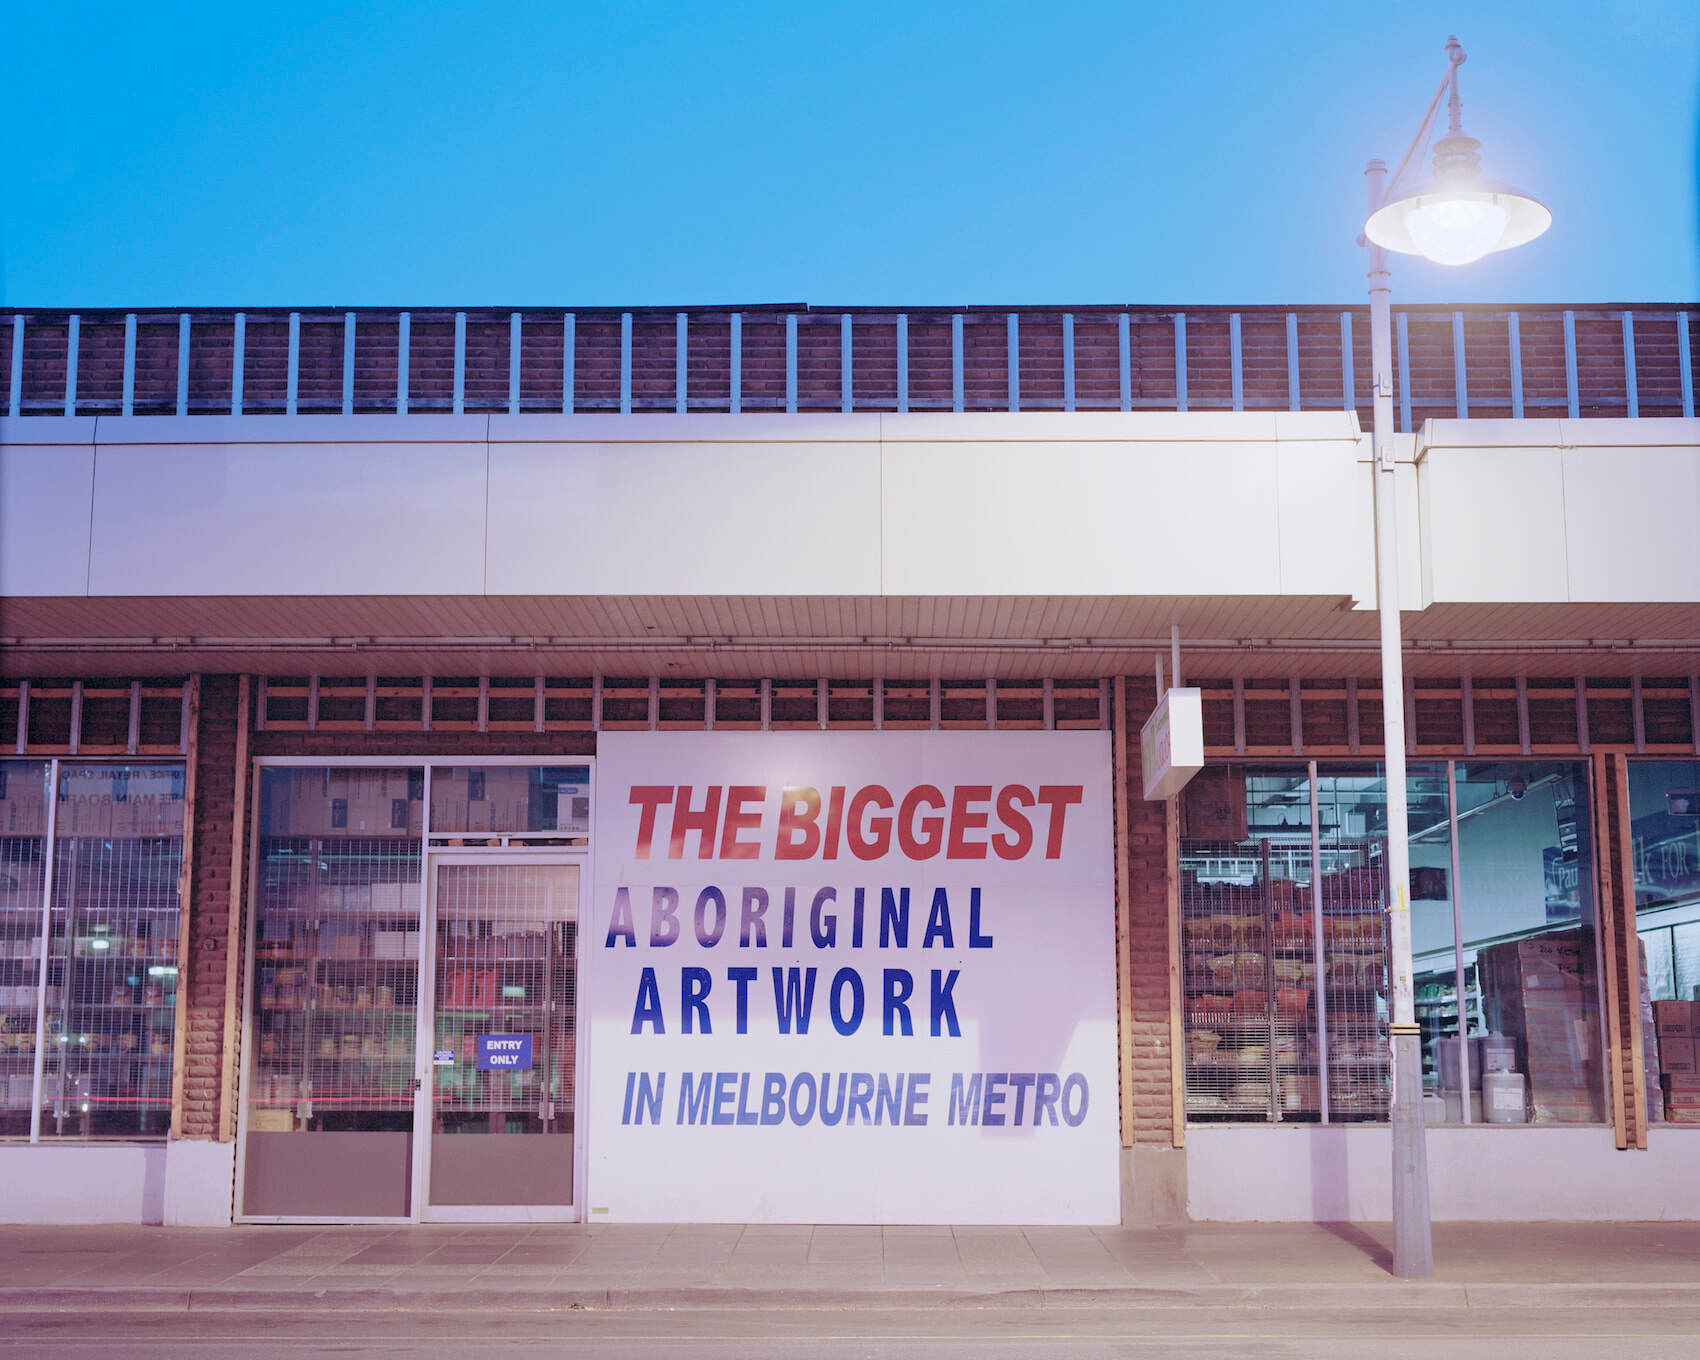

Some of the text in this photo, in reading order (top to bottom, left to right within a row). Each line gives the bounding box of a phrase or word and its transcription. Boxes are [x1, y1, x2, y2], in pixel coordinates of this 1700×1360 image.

[628, 784, 1084, 861] THE BIGGEST
[1661, 841, 1690, 880] FOR
[605, 886, 994, 949] ABORIGINAL
[630, 966, 962, 1038] ARTWORK
[486, 1040, 523, 1050] ENTRY
[489, 1055, 519, 1065] ONLY
[621, 1072, 1090, 1128] IN MELBOURNE METRO
